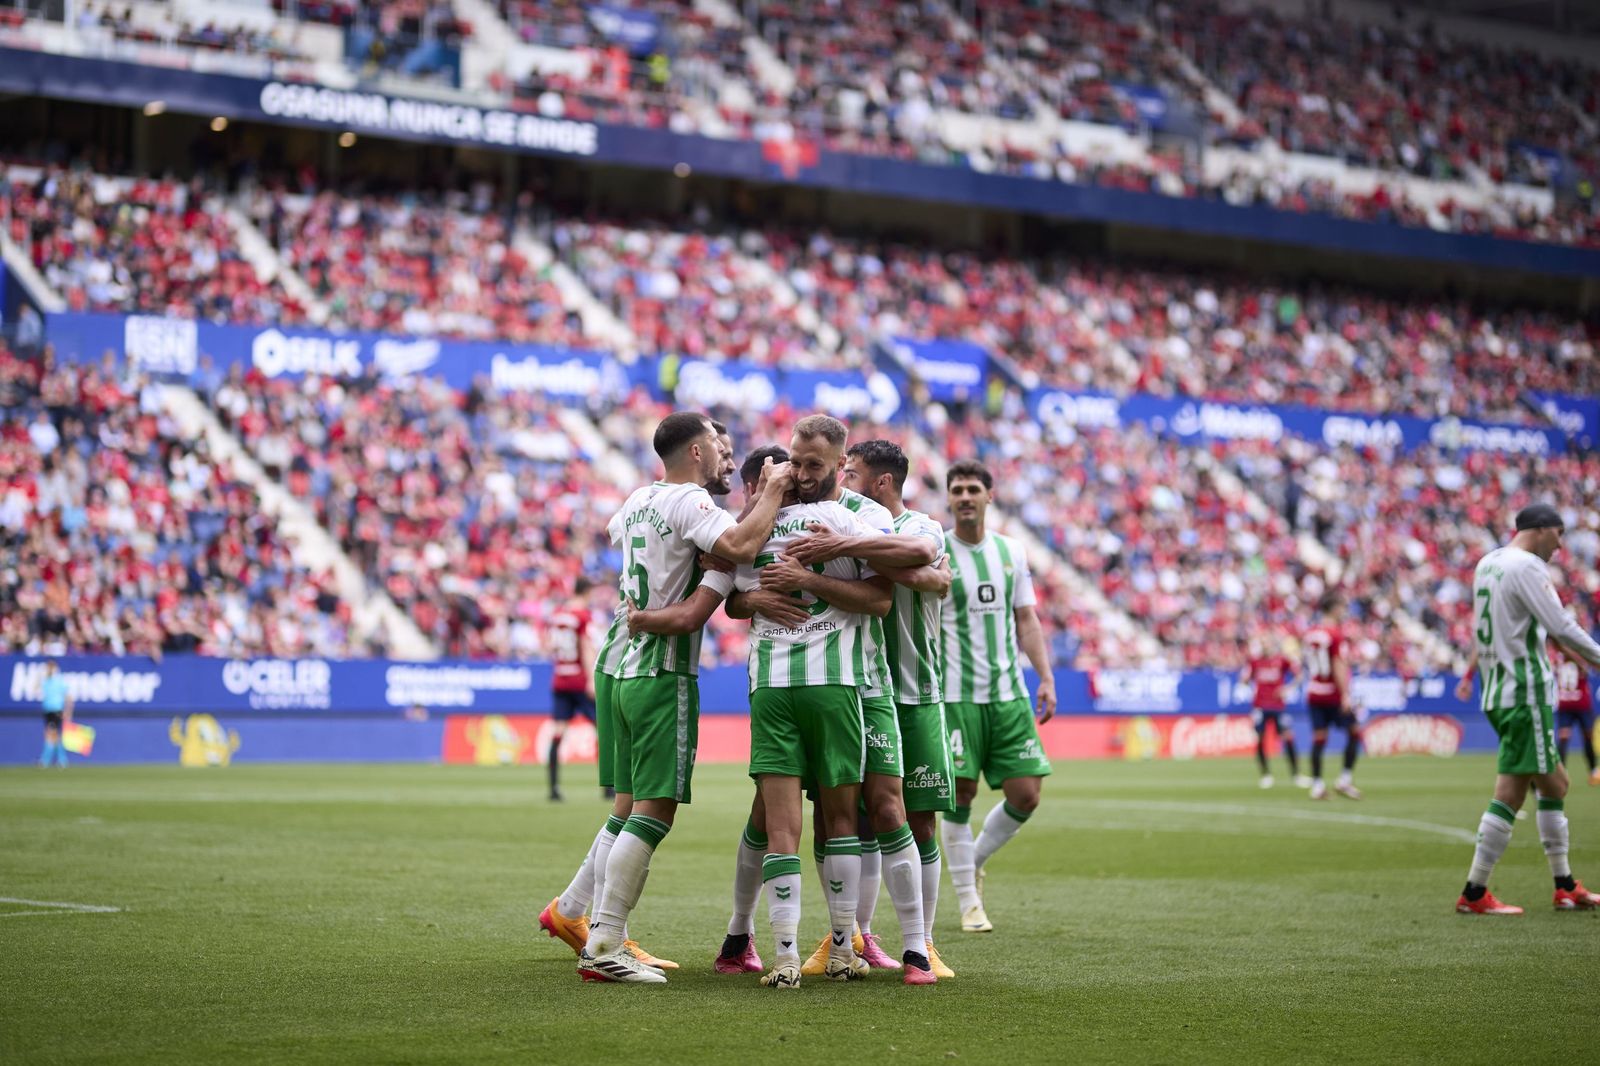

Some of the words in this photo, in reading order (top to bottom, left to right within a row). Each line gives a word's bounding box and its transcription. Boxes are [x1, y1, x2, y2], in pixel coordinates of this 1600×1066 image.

[260, 82, 389, 128] OSASUNA
[390, 98, 482, 140] NUNCA
[483, 111, 517, 145] SE
[628, 536, 650, 611] 5
[805, 621, 837, 633] GREEN
[1476, 588, 1493, 646] 3
[250, 659, 331, 696] CELER
[950, 729, 964, 757] 4
[906, 779, 948, 788] GLOBAL
[920, 773, 941, 781] AUS
